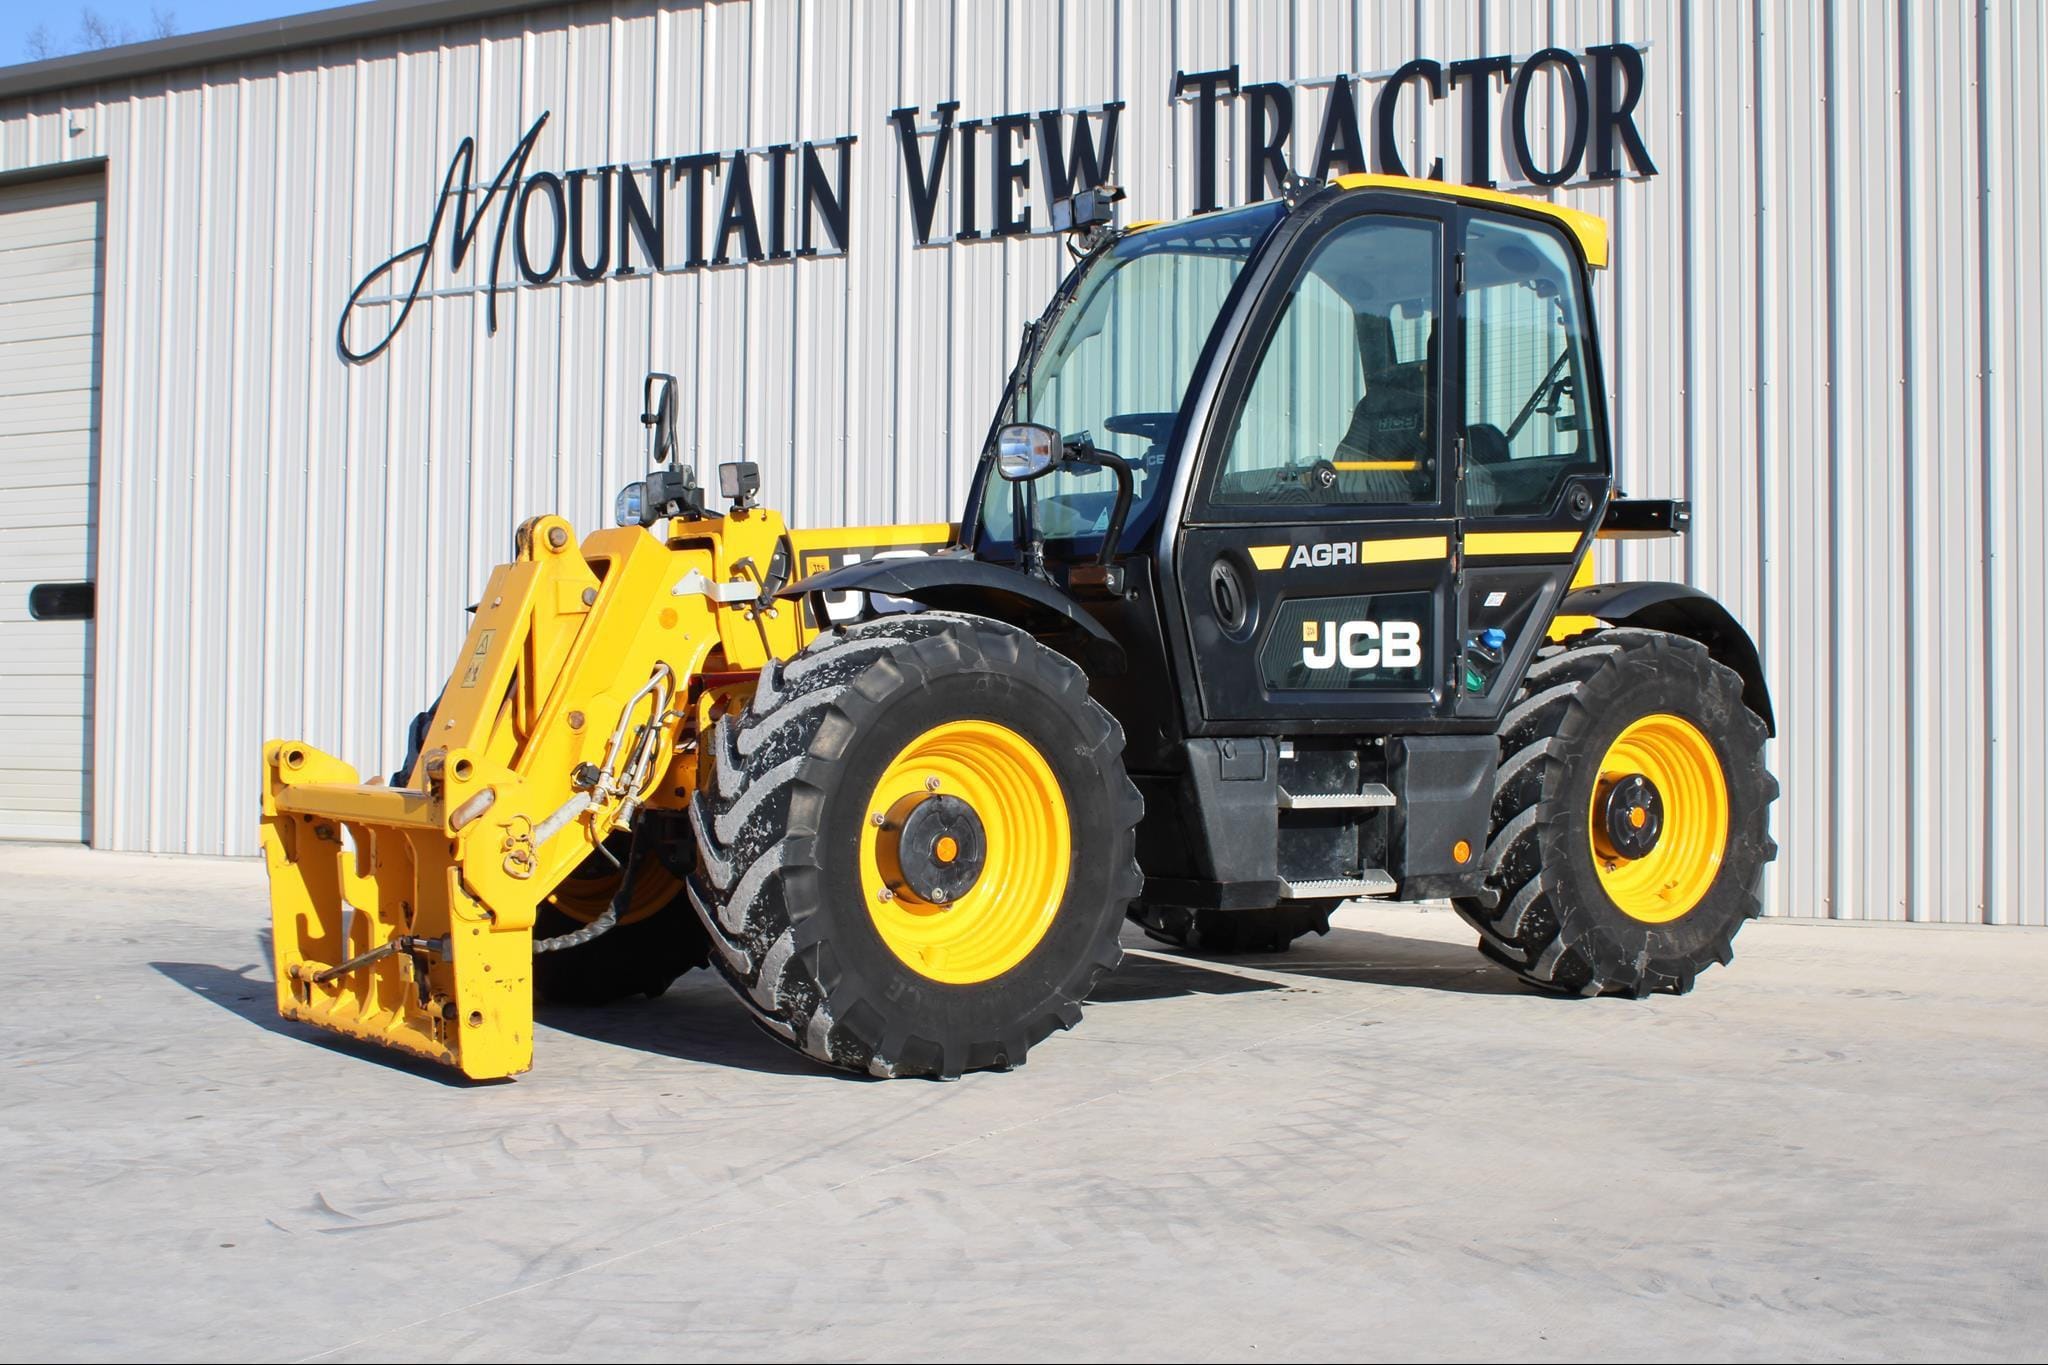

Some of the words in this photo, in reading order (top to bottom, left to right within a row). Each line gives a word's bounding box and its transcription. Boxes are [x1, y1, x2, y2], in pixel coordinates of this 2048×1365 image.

[338, 109, 858, 361] MOUNTAIN
[891, 100, 1126, 245] VIEW
[1175, 43, 1658, 214] TRACTOR
[1290, 541, 1358, 569] AGRI
[1302, 620, 1422, 669] JCB
